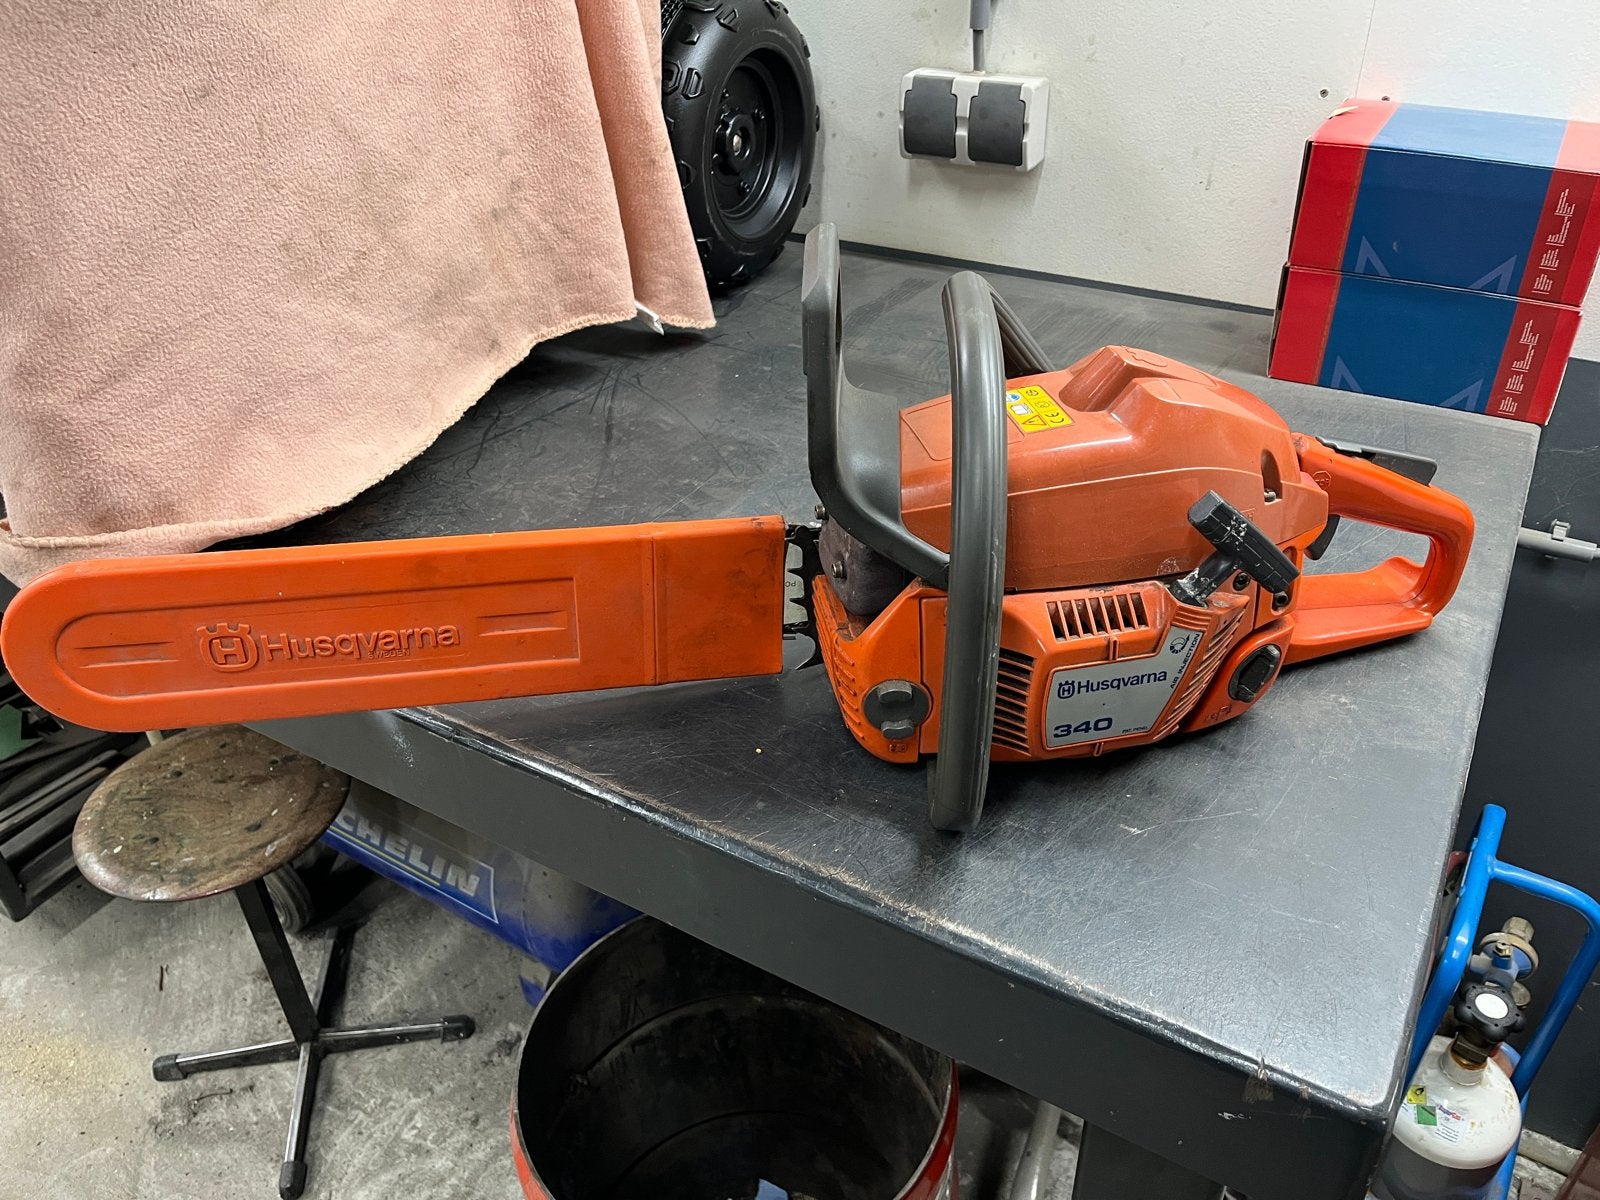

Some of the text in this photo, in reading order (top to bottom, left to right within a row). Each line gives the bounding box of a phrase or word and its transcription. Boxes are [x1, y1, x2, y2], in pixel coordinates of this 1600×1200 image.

[260, 624, 460, 660] Husqvarna
[367, 649, 411, 660] SWEDEN
[1170, 633, 1200, 689] AIR INJECTION
[1077, 670, 1167, 694] Husqvarna
[1053, 717, 1113, 739] 340
[334, 810, 480, 897] CHELIN
